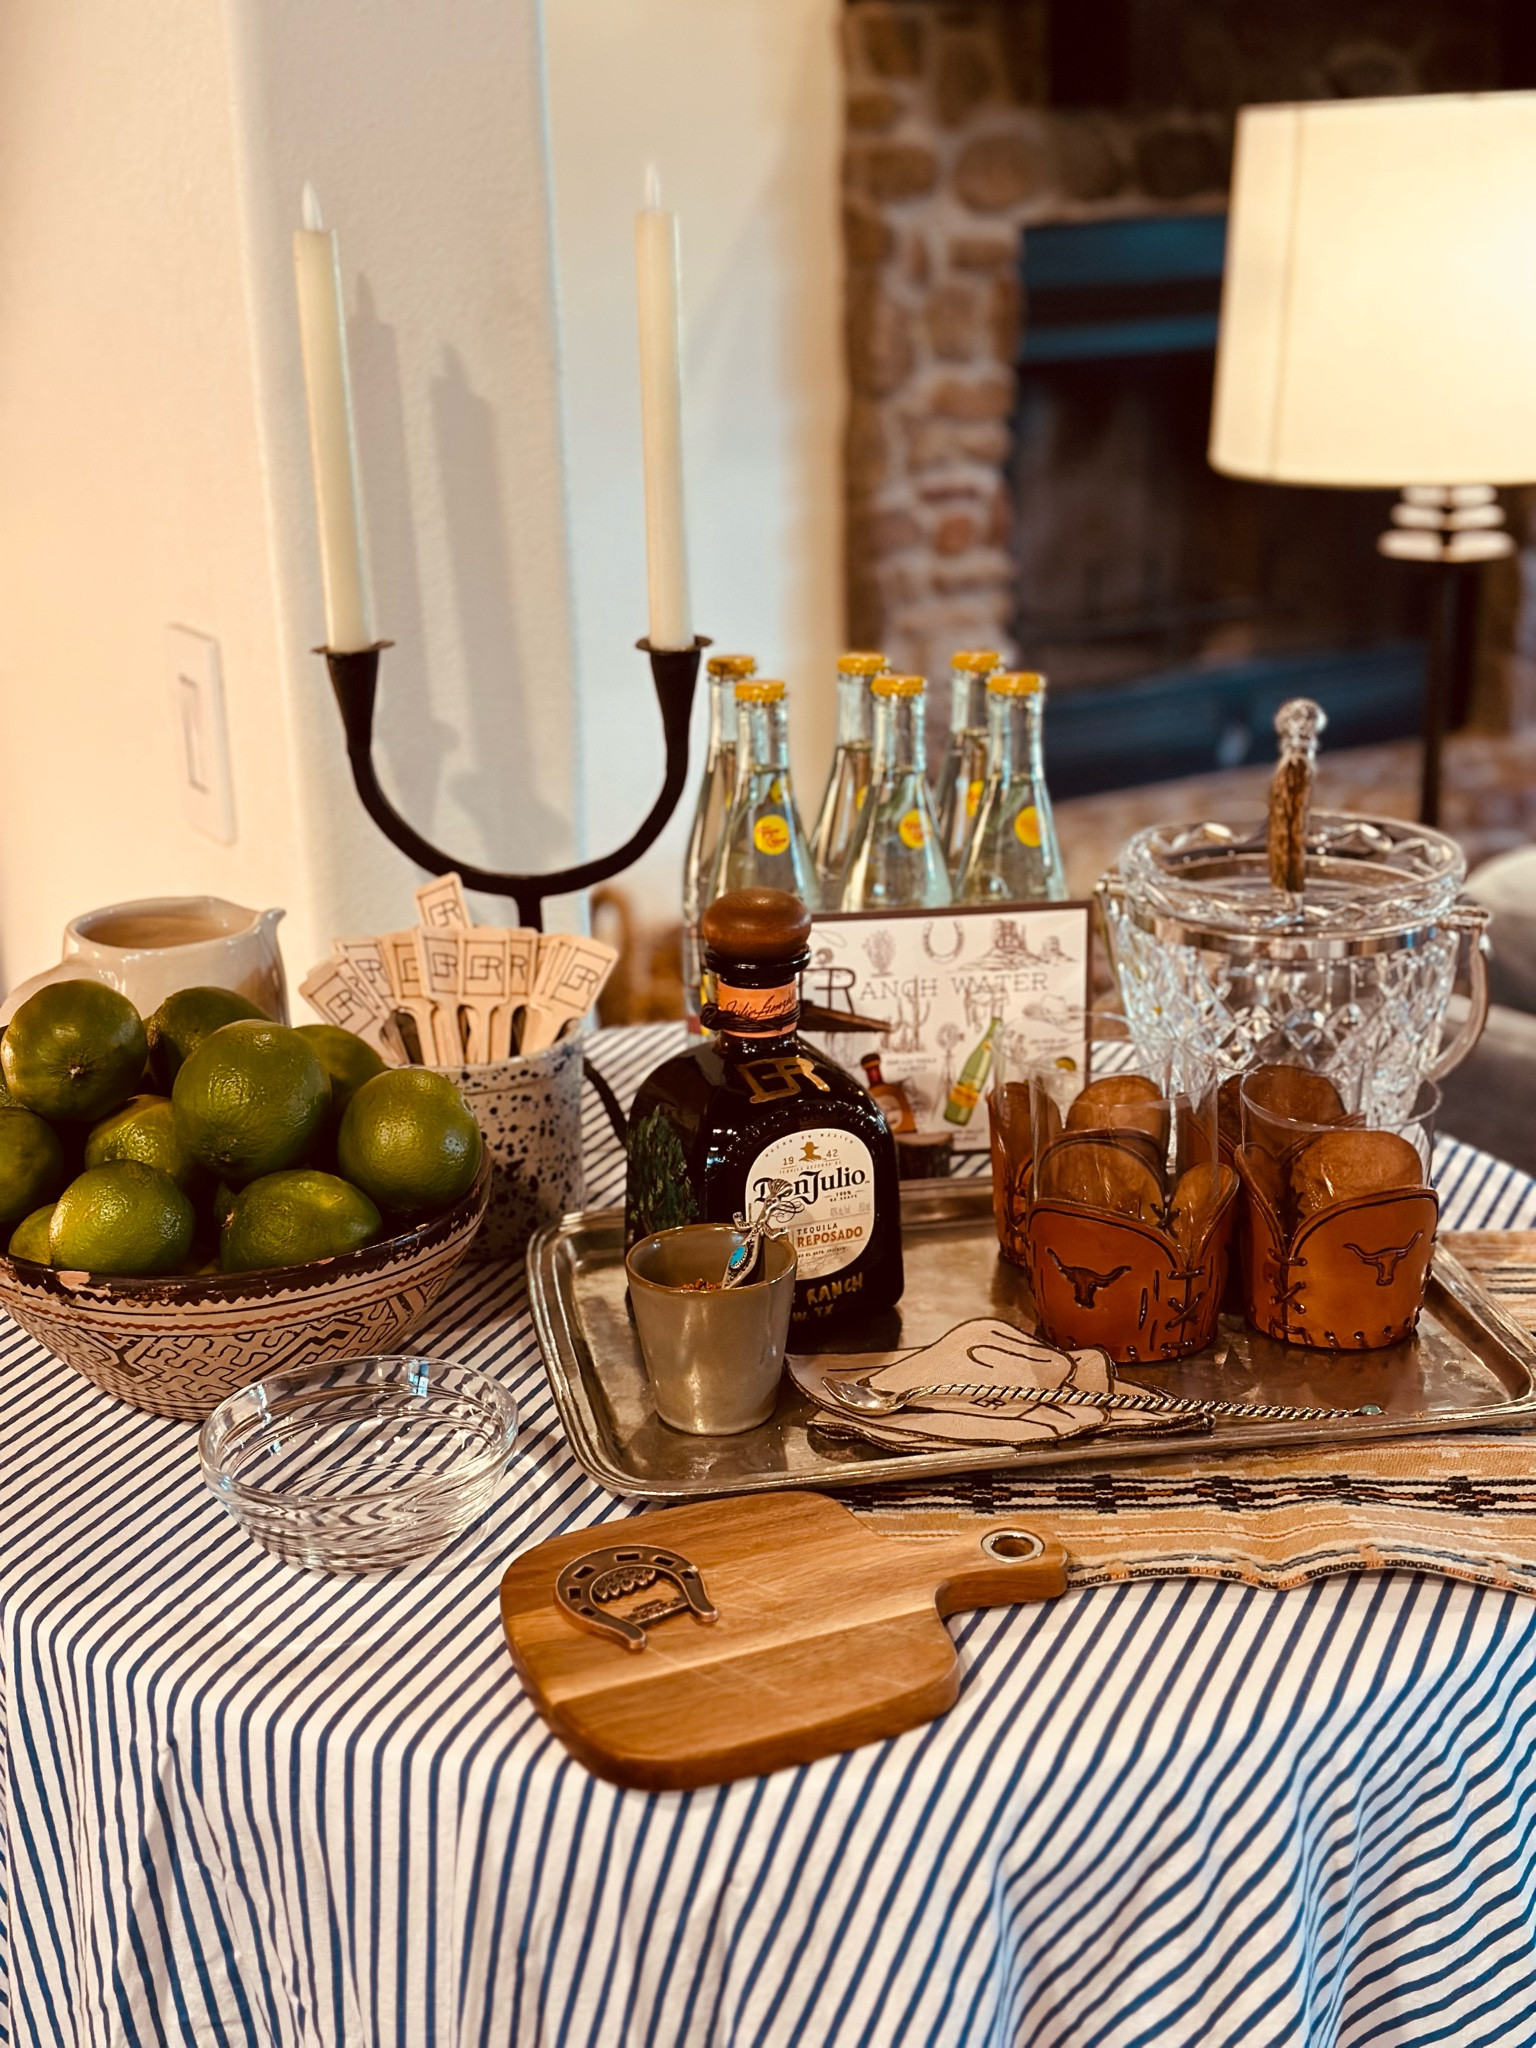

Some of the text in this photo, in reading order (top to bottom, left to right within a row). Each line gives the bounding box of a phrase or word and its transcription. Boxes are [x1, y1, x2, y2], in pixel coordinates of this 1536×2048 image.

[951, 971, 1048, 995] WATER
[782, 1149, 839, 1166] 19 42
[798, 1166, 866, 1205] Julio
[797, 1223, 838, 1235] TEQUILA
[797, 1226, 863, 1248] REPOSADO
[806, 1272, 863, 1305] RANCH
